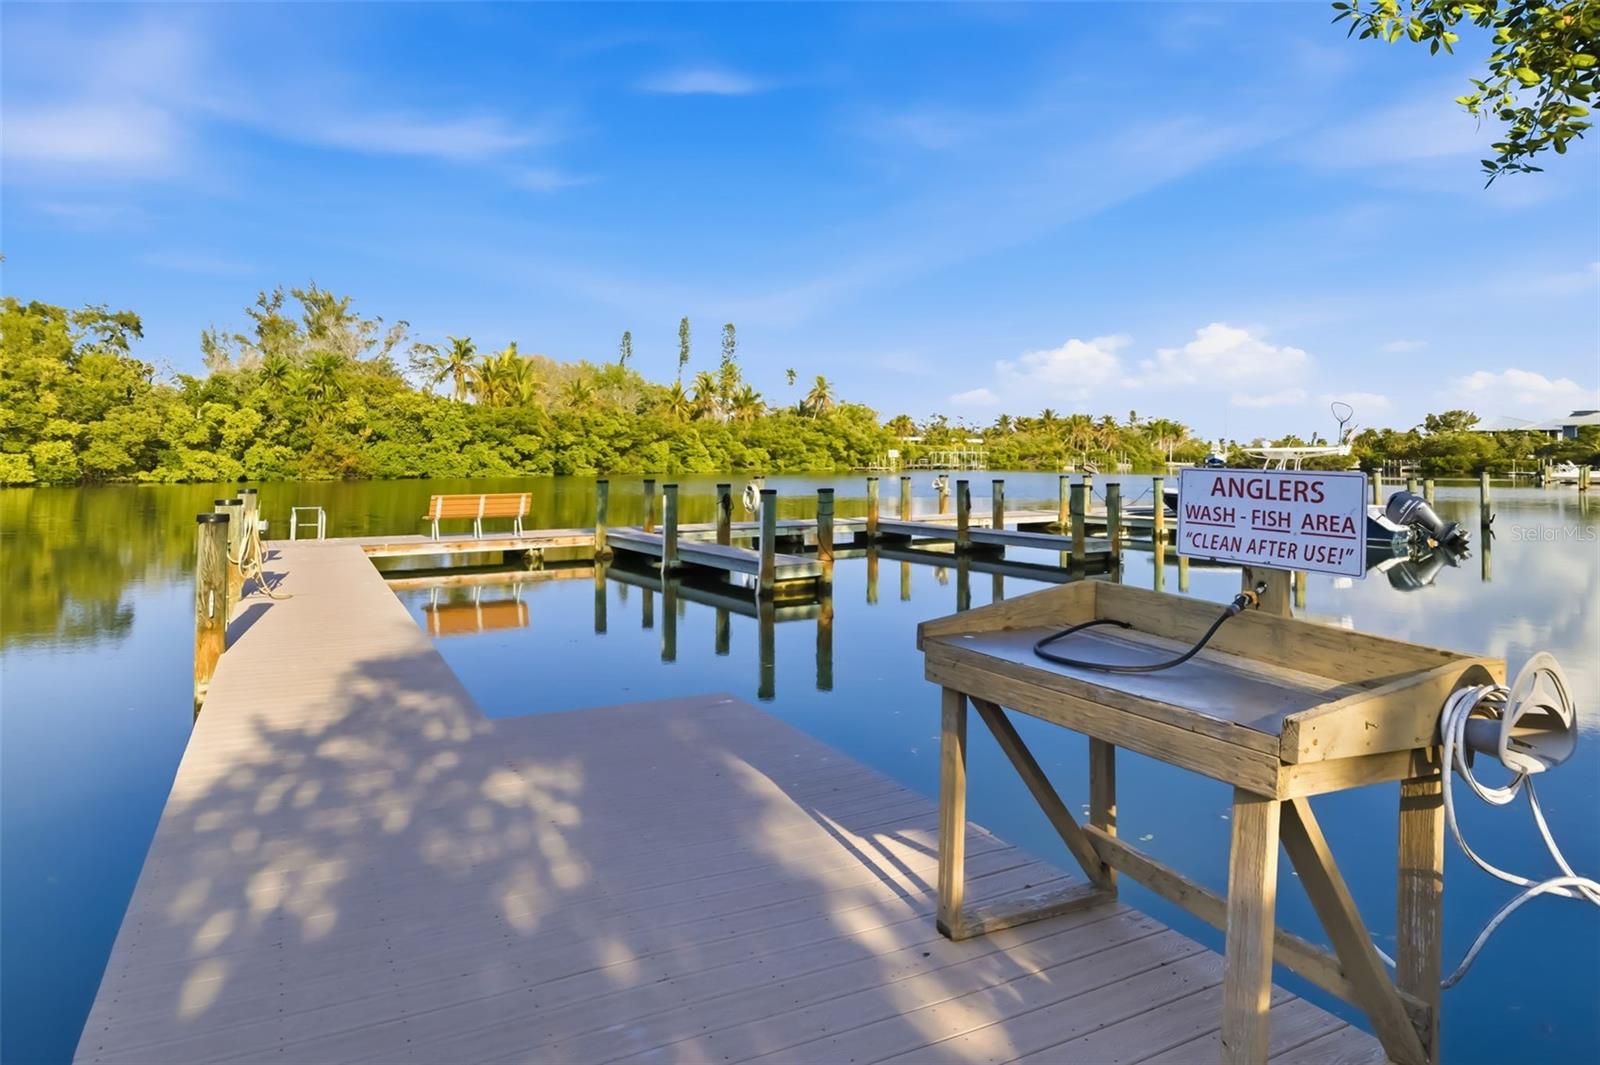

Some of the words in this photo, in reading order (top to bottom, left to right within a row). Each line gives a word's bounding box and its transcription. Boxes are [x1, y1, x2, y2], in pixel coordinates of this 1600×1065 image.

[1211, 477, 1325, 504] ANGLERS
[1185, 504, 1235, 523] WASH
[1251, 509, 1291, 528] FISH
[1301, 513, 1356, 534] AREA
[1246, 538, 1298, 560] AFTER
